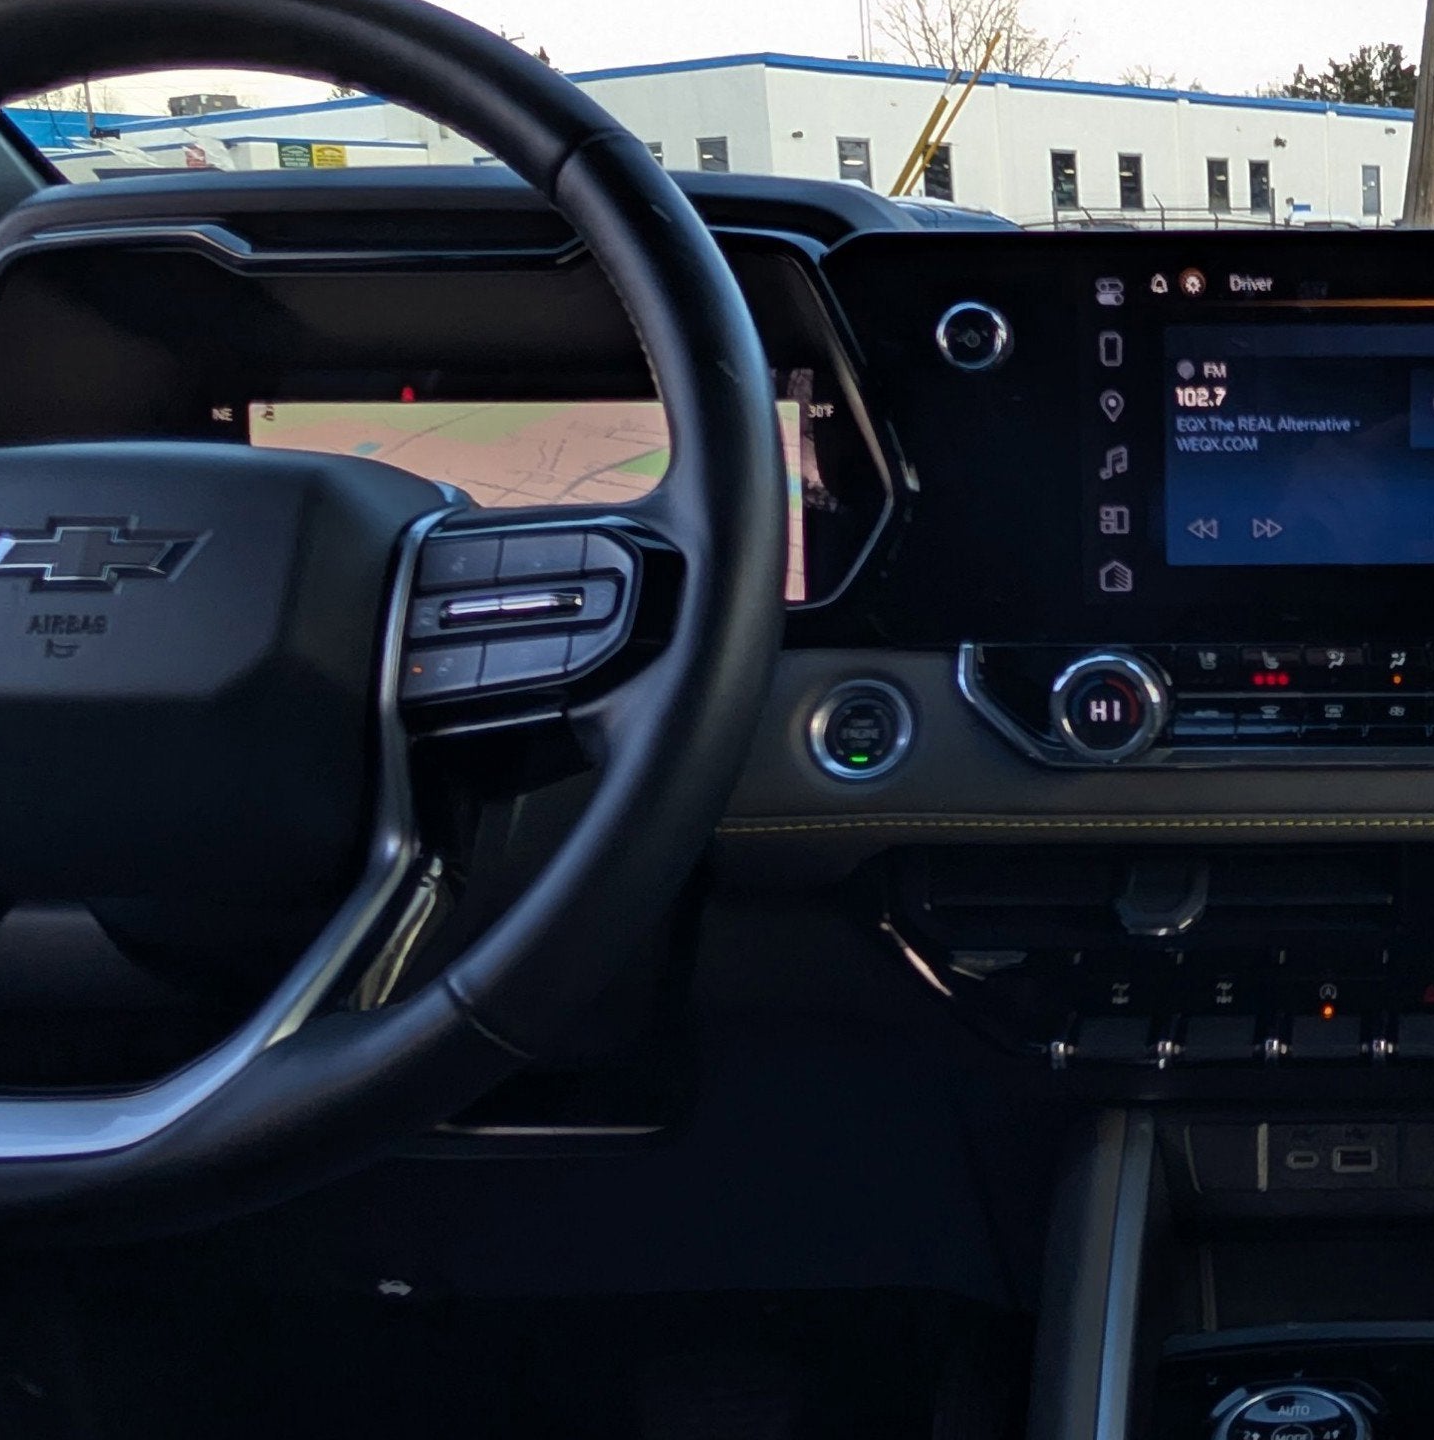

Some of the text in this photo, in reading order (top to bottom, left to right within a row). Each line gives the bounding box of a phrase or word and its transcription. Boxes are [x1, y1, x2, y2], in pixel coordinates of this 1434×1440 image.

[1230, 274, 1273, 292] Driver
[1203, 362, 1227, 378] FM
[1176, 387, 1226, 407] 102.7
[1176, 416, 1207, 433] EQX
[1208, 415, 1235, 432] The
[1238, 416, 1275, 432] REAL
[1278, 415, 1351, 432] Alternative
[1176, 436, 1258, 452] WEQX.COM
[26, 615, 107, 634] AIRBAG
[1090, 699, 1122, 721] HI
[1278, 1405, 1310, 1416] AUTO
